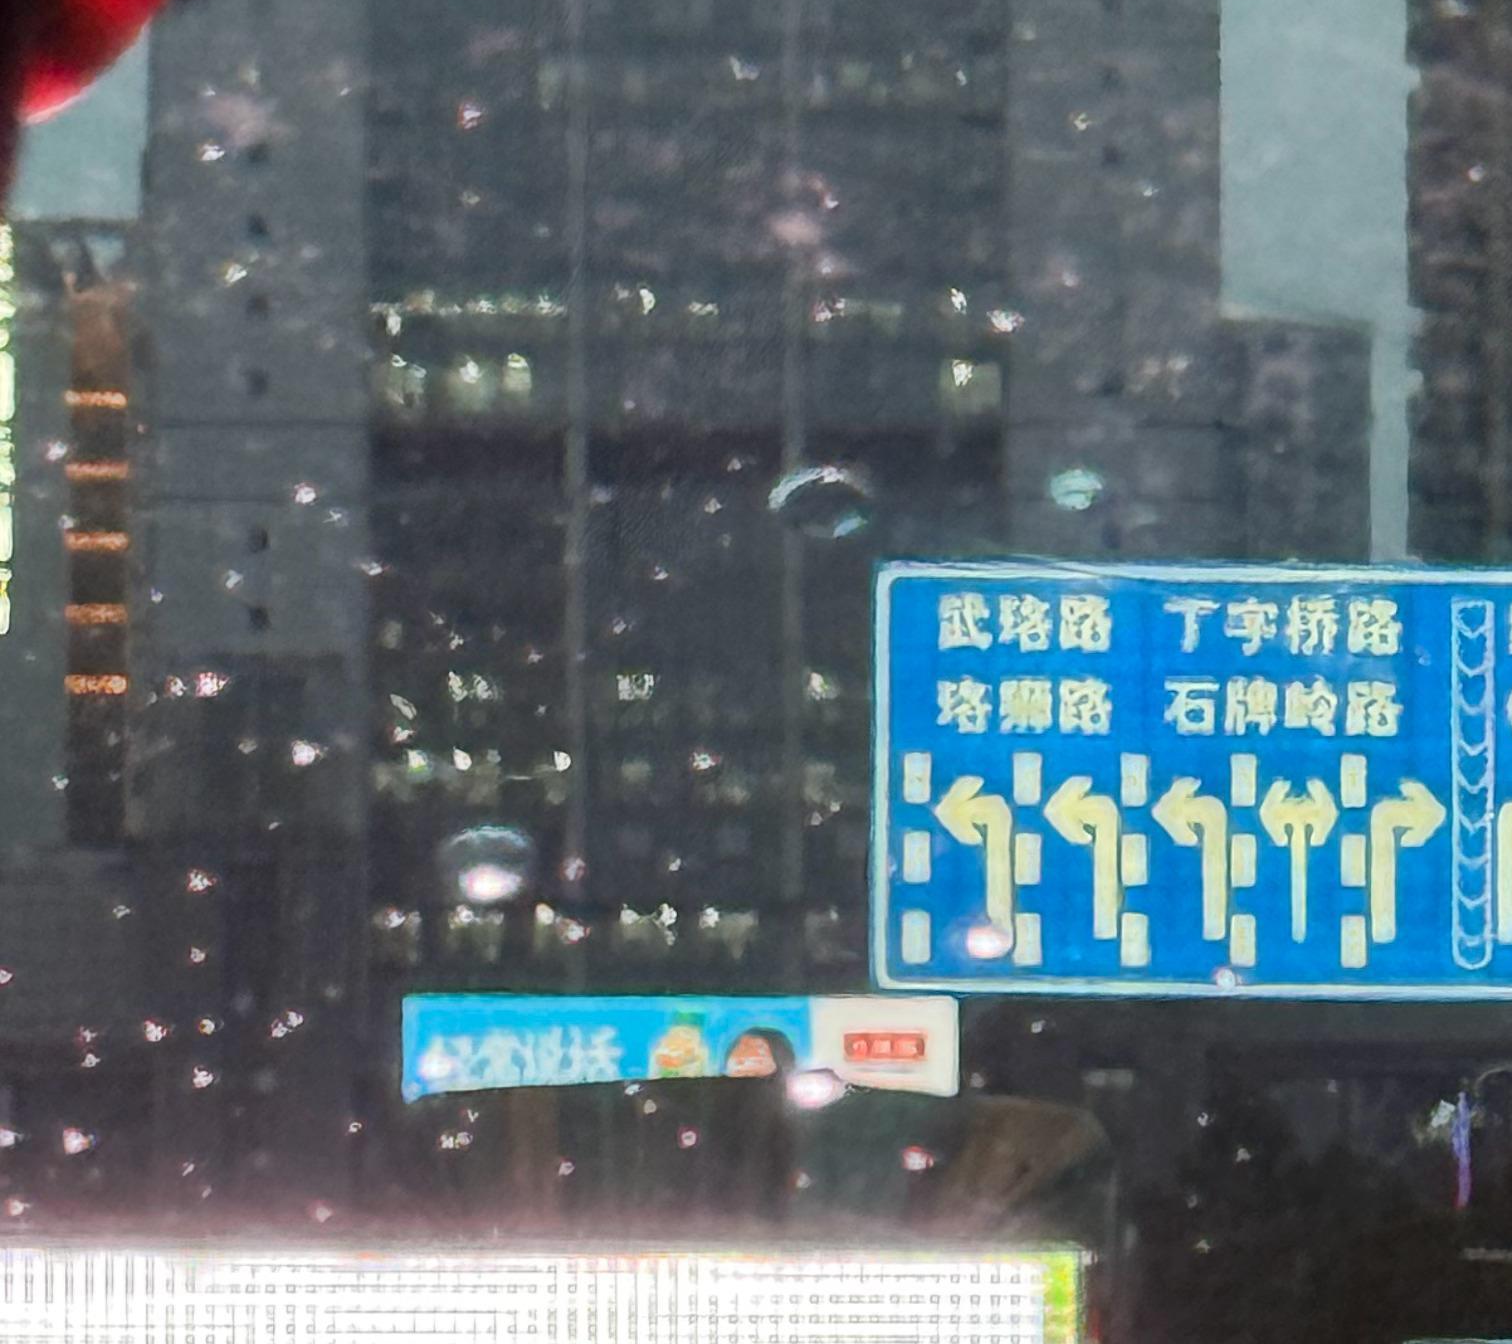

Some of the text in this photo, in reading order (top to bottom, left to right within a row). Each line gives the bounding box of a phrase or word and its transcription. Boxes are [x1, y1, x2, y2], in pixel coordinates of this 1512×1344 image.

[937, 592, 1112, 653] 武珞路
[1163, 595, 1403, 656] 丁字桥路
[1163, 675, 1404, 737] 石牌岭路
